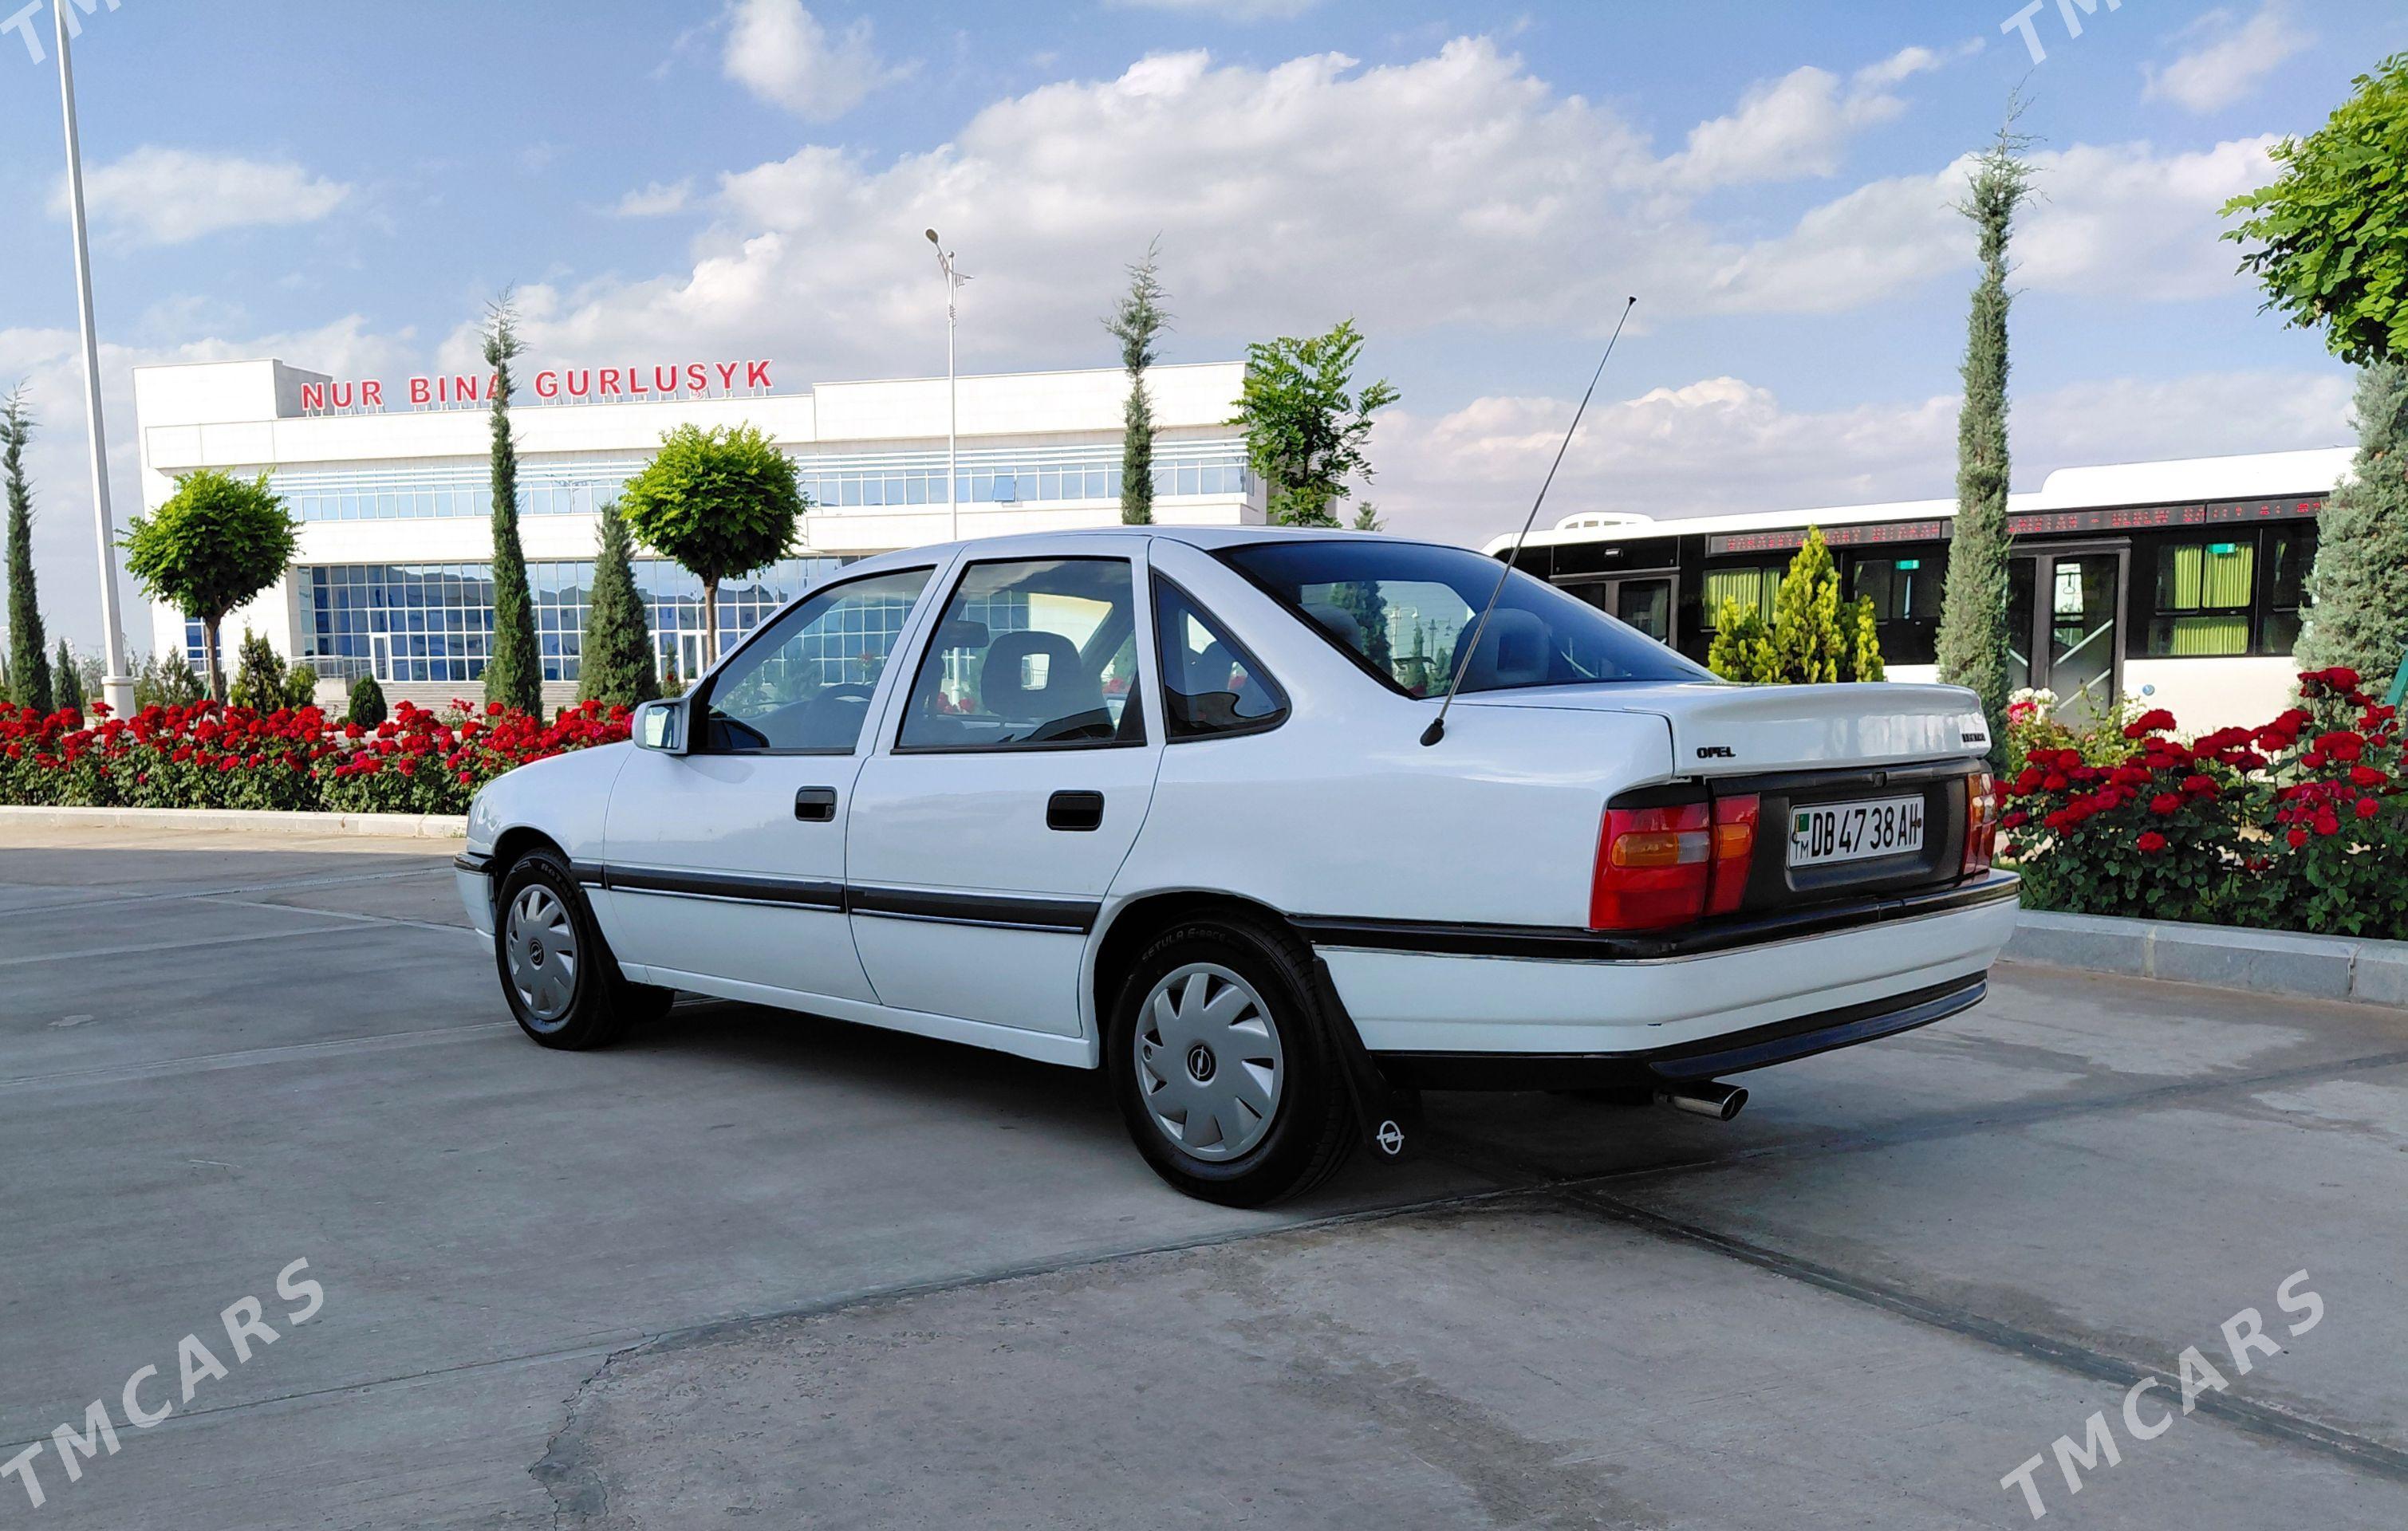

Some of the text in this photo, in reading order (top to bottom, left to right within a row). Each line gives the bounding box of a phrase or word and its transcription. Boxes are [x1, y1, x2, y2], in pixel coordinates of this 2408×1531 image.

[301, 379, 384, 410] NUR
[1697, 746, 1736, 758] OPEL
[1811, 811, 1835, 858] DB
[1839, 808, 1867, 853] 47
[1870, 805, 1894, 850] 38
